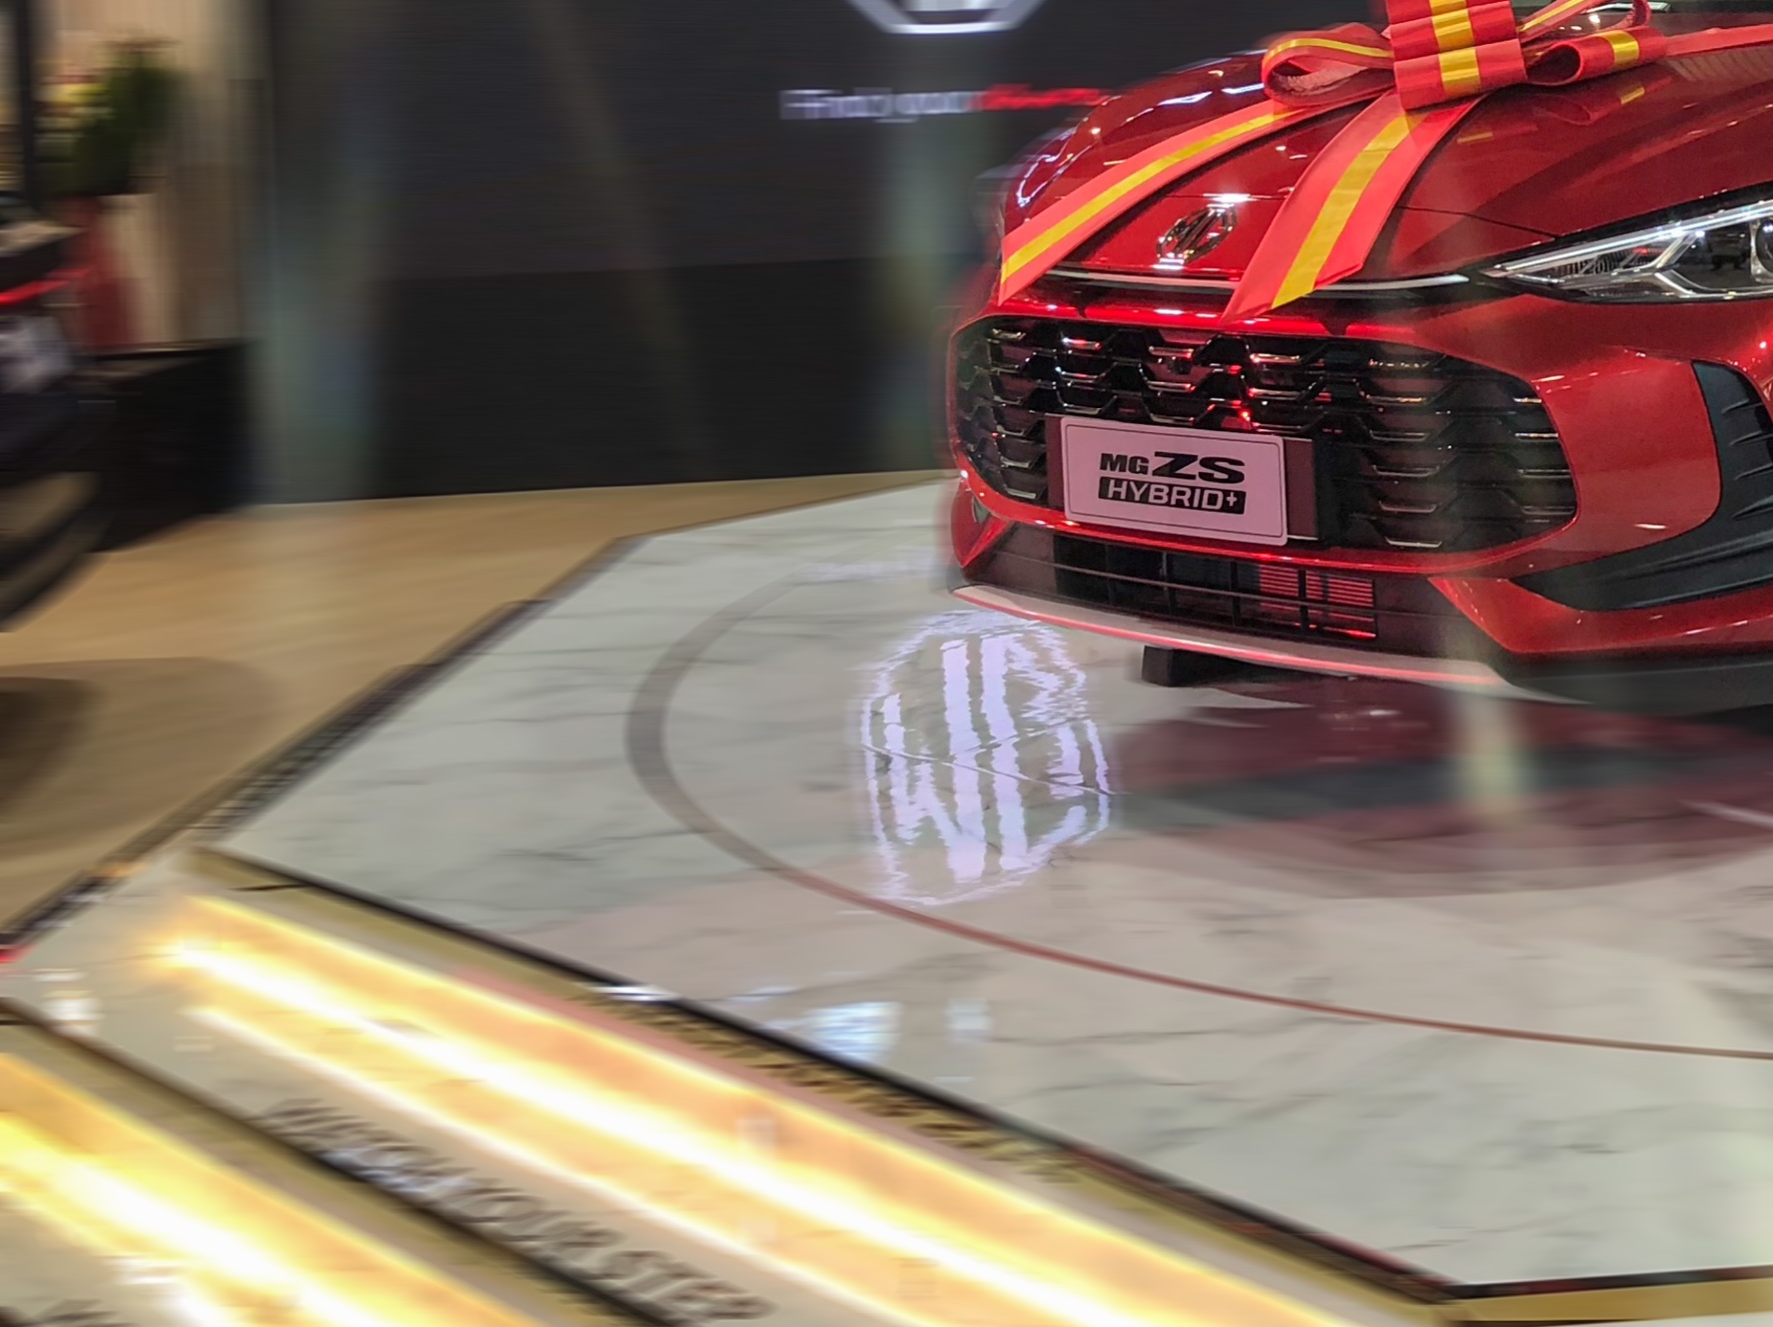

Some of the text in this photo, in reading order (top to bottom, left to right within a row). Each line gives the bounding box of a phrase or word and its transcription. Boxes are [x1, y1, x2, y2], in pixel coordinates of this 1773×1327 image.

[1100, 451, 1245, 484] MG ZS
[1107, 479, 1238, 511] HYBRID+
